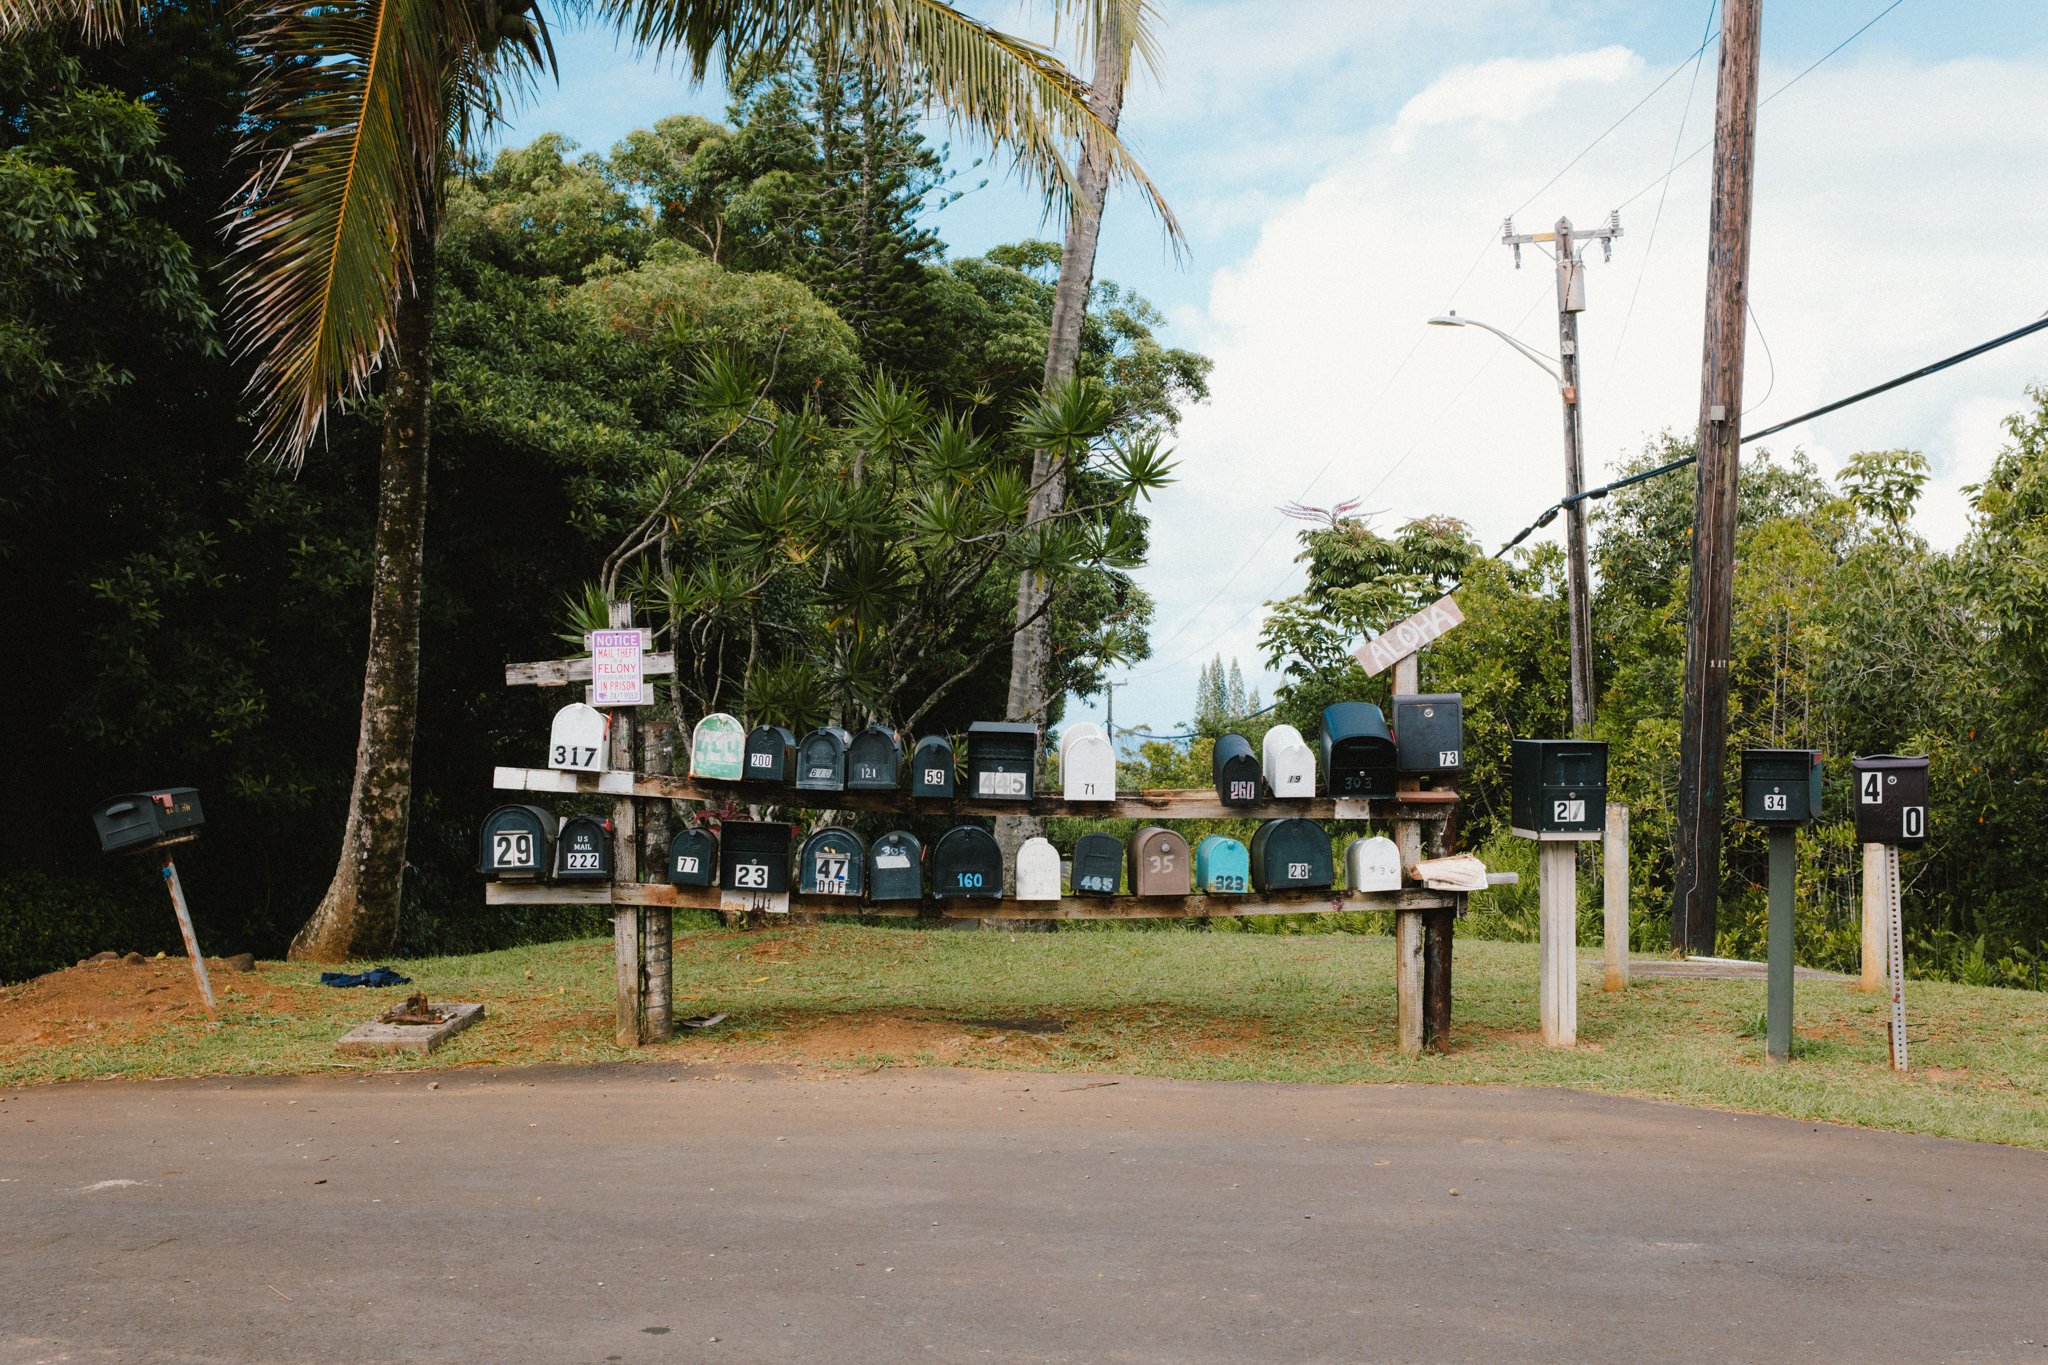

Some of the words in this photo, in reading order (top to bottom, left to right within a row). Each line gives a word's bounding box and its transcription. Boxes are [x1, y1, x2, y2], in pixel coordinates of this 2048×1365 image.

[596, 635, 638, 646] NOTICE
[1370, 606, 1458, 671] ALOHA
[598, 648, 614, 658] MAIL
[617, 648, 637, 658] THEFT
[598, 663, 637, 674] FELONY
[600, 681, 608, 691] IN
[610, 681, 636, 691] PRISON
[554, 746, 597, 767] 317
[752, 754, 771, 767] 200
[1441, 752, 1457, 765] 73
[861, 767, 876, 779] 121
[926, 769, 943, 784] 59
[1084, 783, 1095, 795] 71
[1230, 781, 1255, 800] 260
[1344, 777, 1372, 790] 303
[1864, 773, 1880, 802] 4
[1767, 796, 1784, 810] 34
[1557, 802, 1583, 820] 27
[496, 835, 532, 866] 29
[574, 843, 592, 851] MAIL
[881, 846, 907, 856] 305
[569, 854, 598, 868] 222
[680, 857, 697, 872] 77
[1149, 855, 1175, 874] 35
[737, 866, 766, 886] 23
[817, 859, 846, 880] 47
[1290, 864, 1307, 878] 28
[957, 873, 983, 888] 160
[1080, 875, 1113, 892] 465
